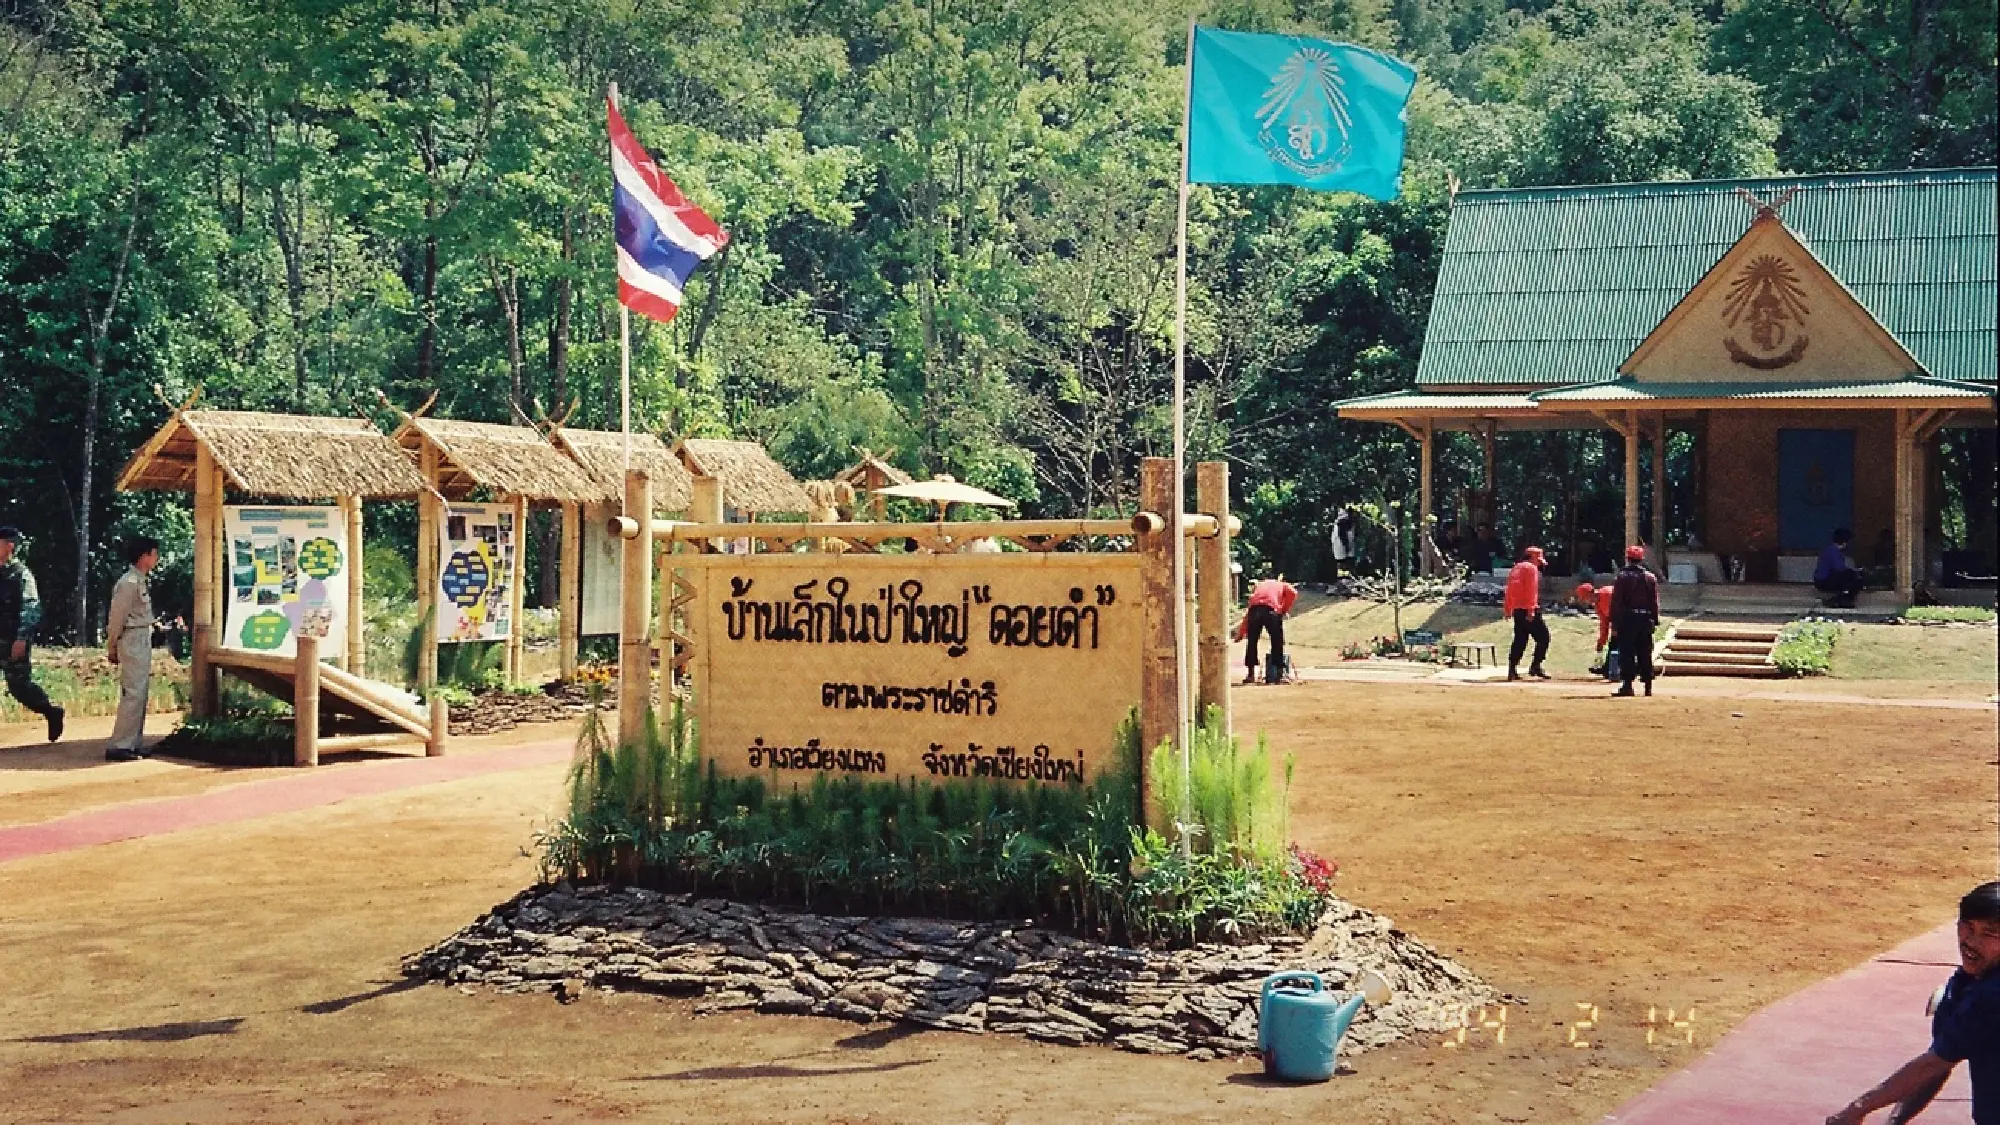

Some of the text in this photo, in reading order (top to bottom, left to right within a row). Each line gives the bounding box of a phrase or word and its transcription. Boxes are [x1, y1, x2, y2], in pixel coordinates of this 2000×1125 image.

[821, 677, 998, 717] ตามพระราชดำริ
[747, 736, 1084, 784] อำเภอเวียงแหง จังหวัดเชียงใหม่
